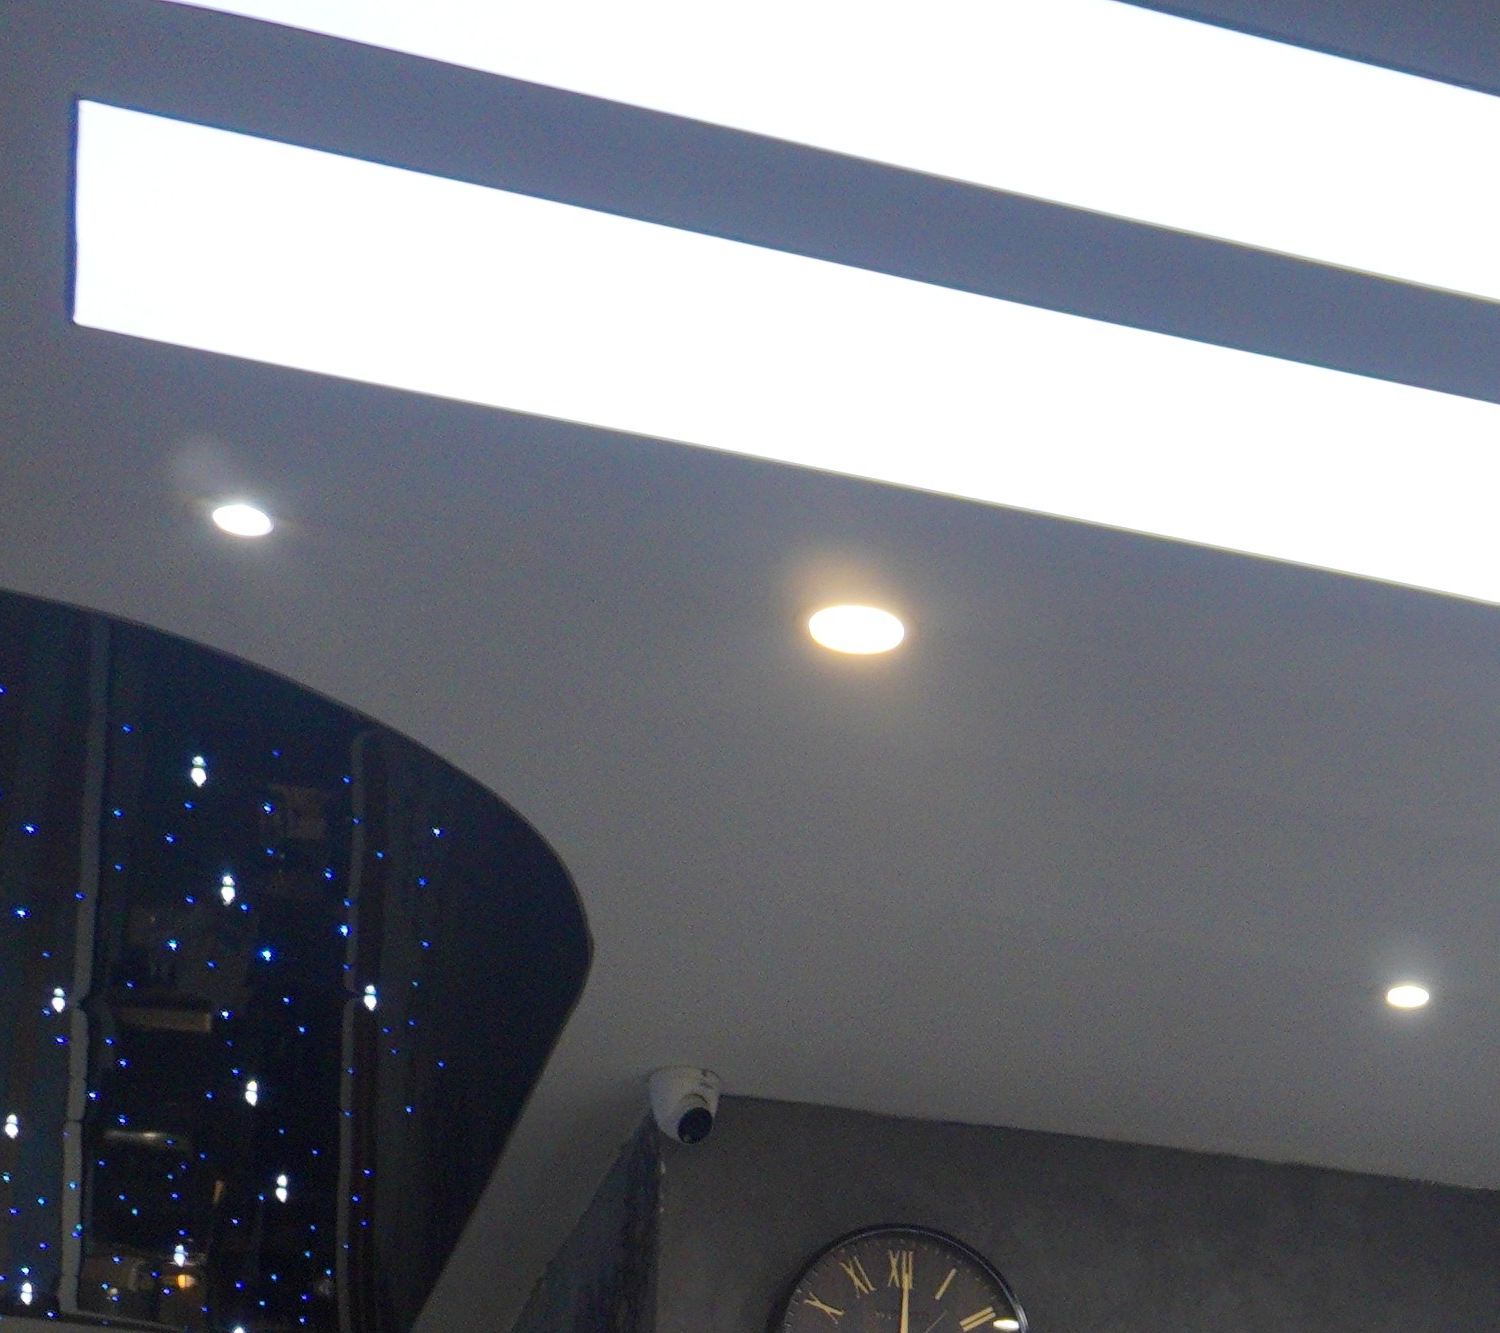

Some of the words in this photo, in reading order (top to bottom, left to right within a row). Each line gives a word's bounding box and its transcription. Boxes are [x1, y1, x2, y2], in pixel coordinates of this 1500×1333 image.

[840, 1255, 877, 1299] XI
[804, 1291, 846, 1325] X
[959, 1305, 997, 1333] II
